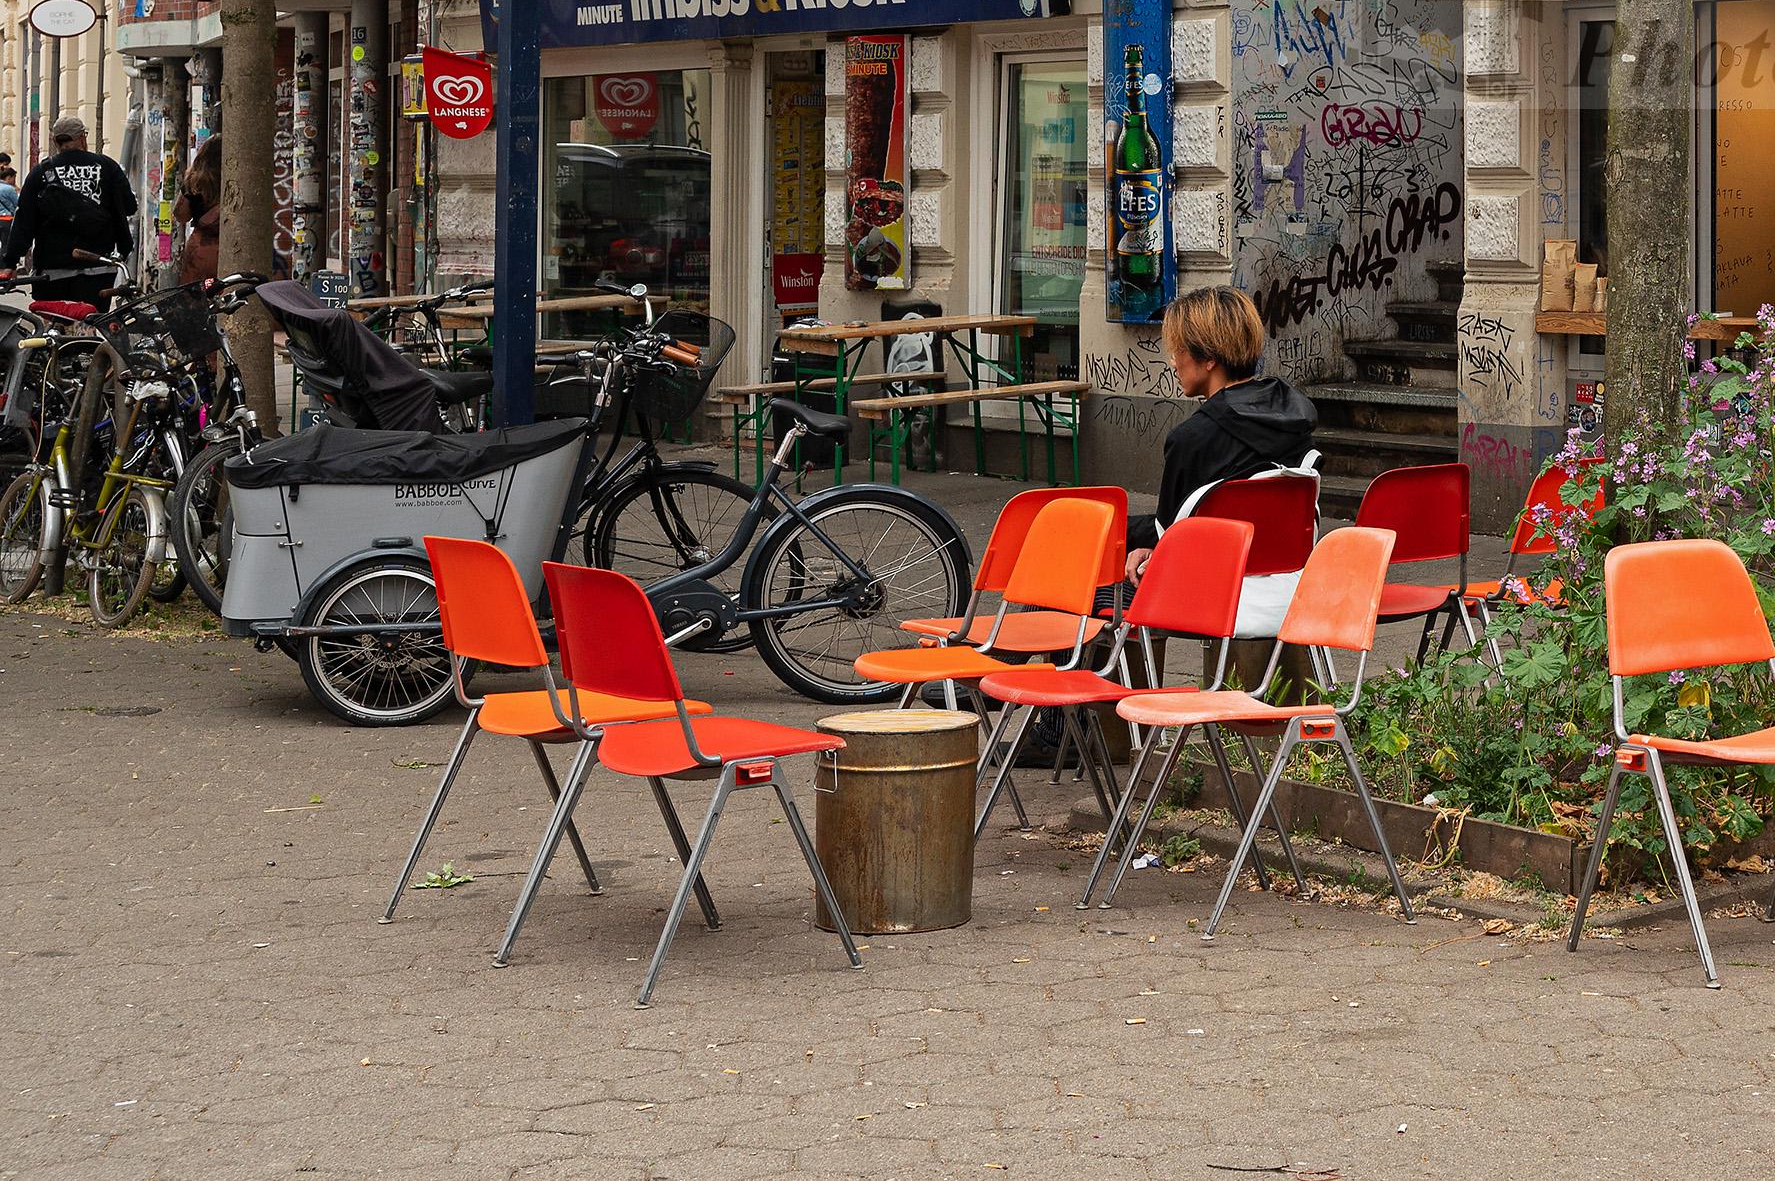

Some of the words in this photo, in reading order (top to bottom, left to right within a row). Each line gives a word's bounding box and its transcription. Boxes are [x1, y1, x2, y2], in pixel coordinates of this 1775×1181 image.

[576, 3, 624, 26] MINUTE
[352, 28, 366, 40] 16
[863, 42, 901, 60] KIOSK
[1125, 80, 1144, 90] EFES
[1046, 90, 1071, 105] Winston
[434, 107, 487, 118] LANGNESE
[321, 280, 330, 293] S
[334, 285, 348, 294] 100
[780, 274, 814, 289] Winston
[395, 483, 461, 499] BABBOE
[395, 499, 463, 508] www.babboe.com
